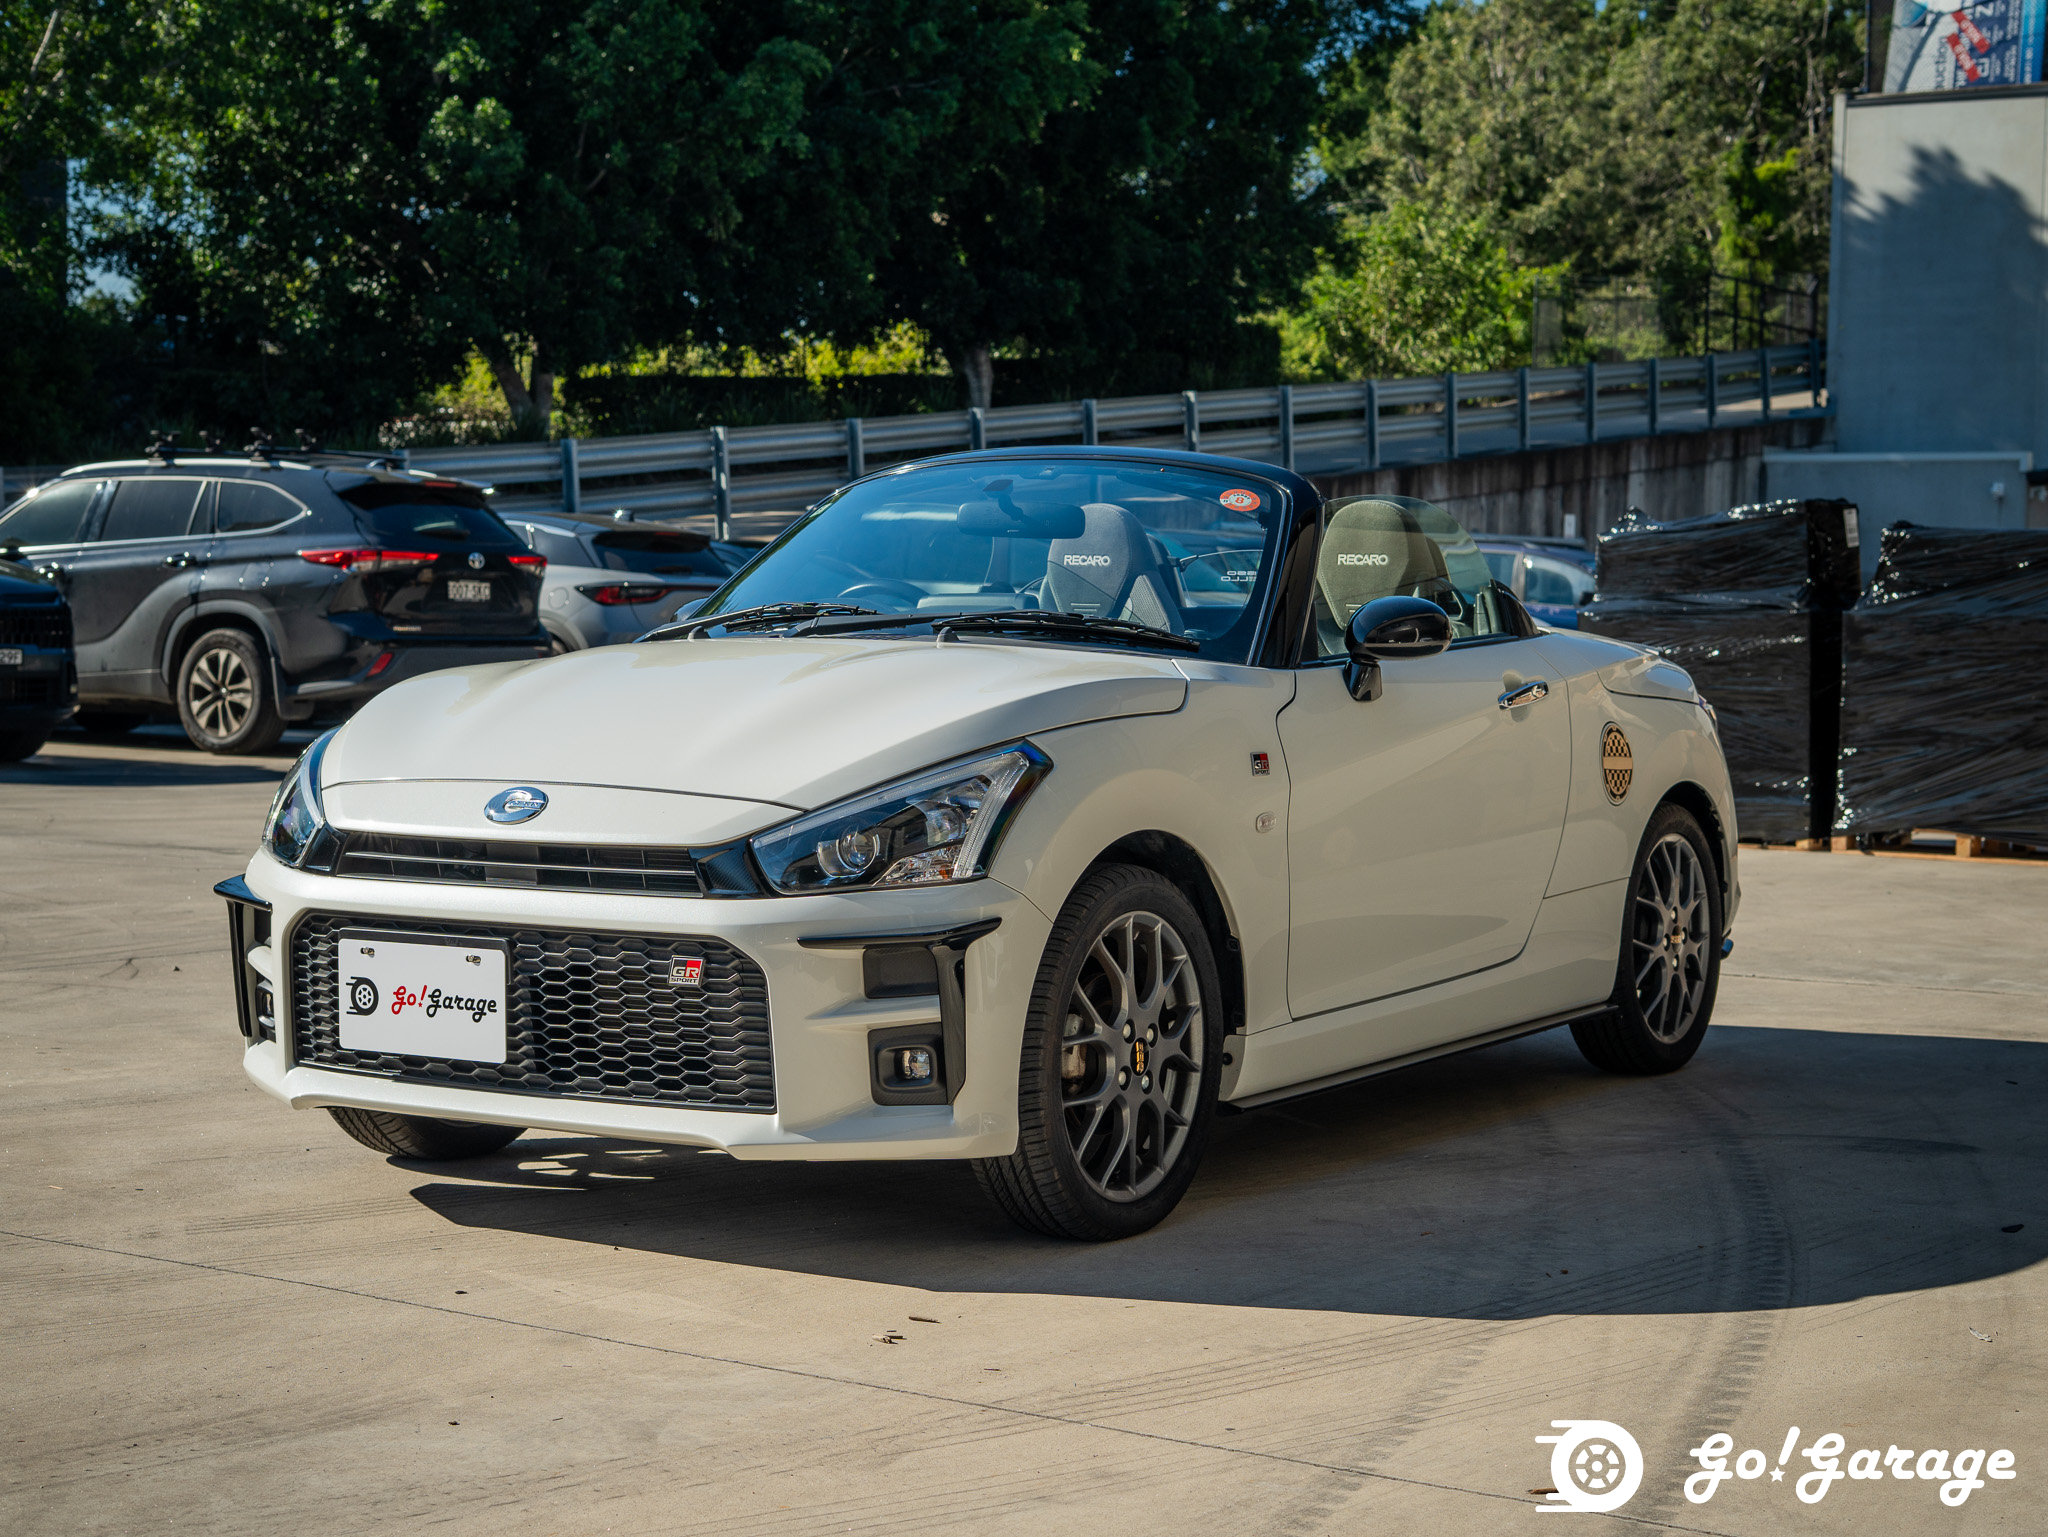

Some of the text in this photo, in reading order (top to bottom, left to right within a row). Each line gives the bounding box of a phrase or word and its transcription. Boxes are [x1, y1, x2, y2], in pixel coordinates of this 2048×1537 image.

[1063, 554, 1110, 567] RECARO
[1337, 553, 1389, 566] RECARO
[1254, 759, 1269, 770] GR
[672, 966, 699, 978] GR
